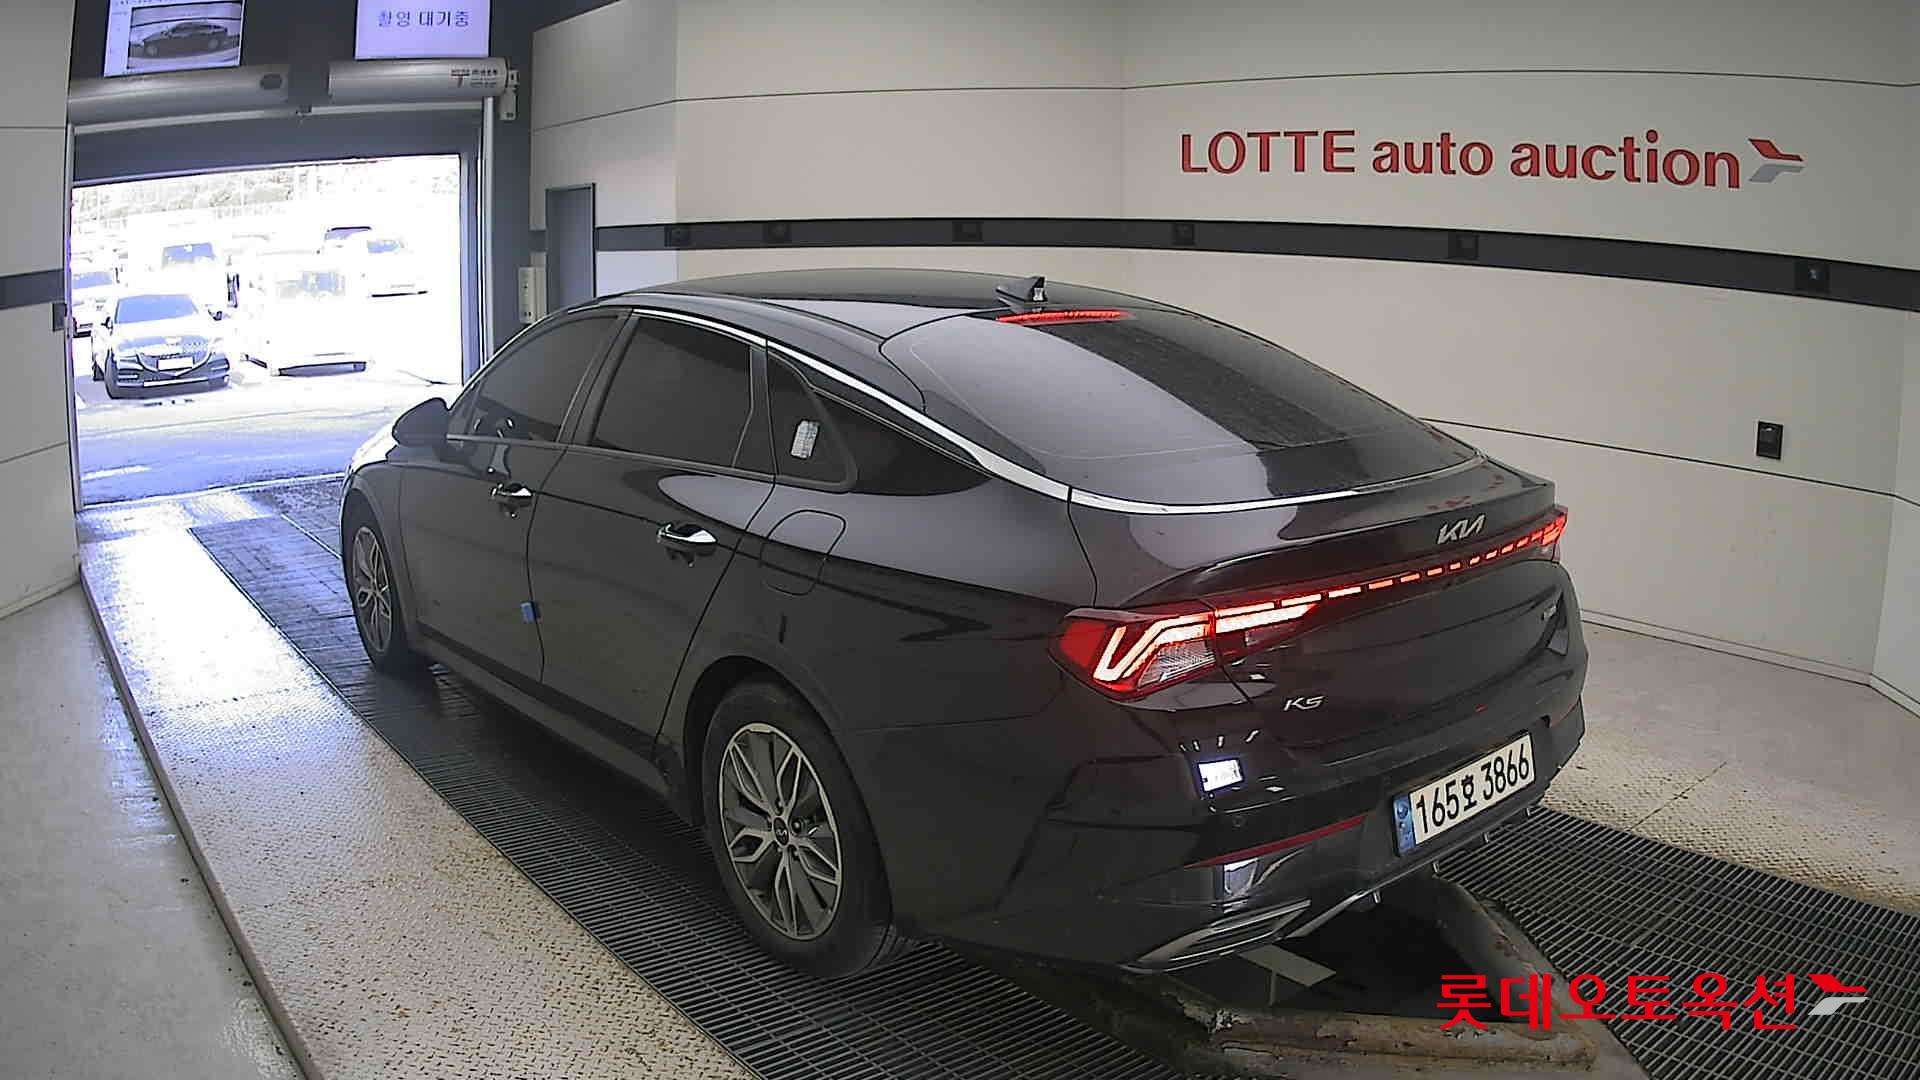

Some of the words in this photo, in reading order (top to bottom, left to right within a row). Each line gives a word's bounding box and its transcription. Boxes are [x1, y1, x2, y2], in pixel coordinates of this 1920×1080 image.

[419, 10, 470, 28] 대기중
[1181, 130, 1355, 174] LOTTE
[1372, 132, 1494, 176] auto
[1510, 129, 1740, 189] auction
[1437, 514, 1486, 545] KIA
[1283, 695, 1325, 711] K5
[1416, 774, 1477, 834] 165호
[1480, 743, 1530, 801] 3866
